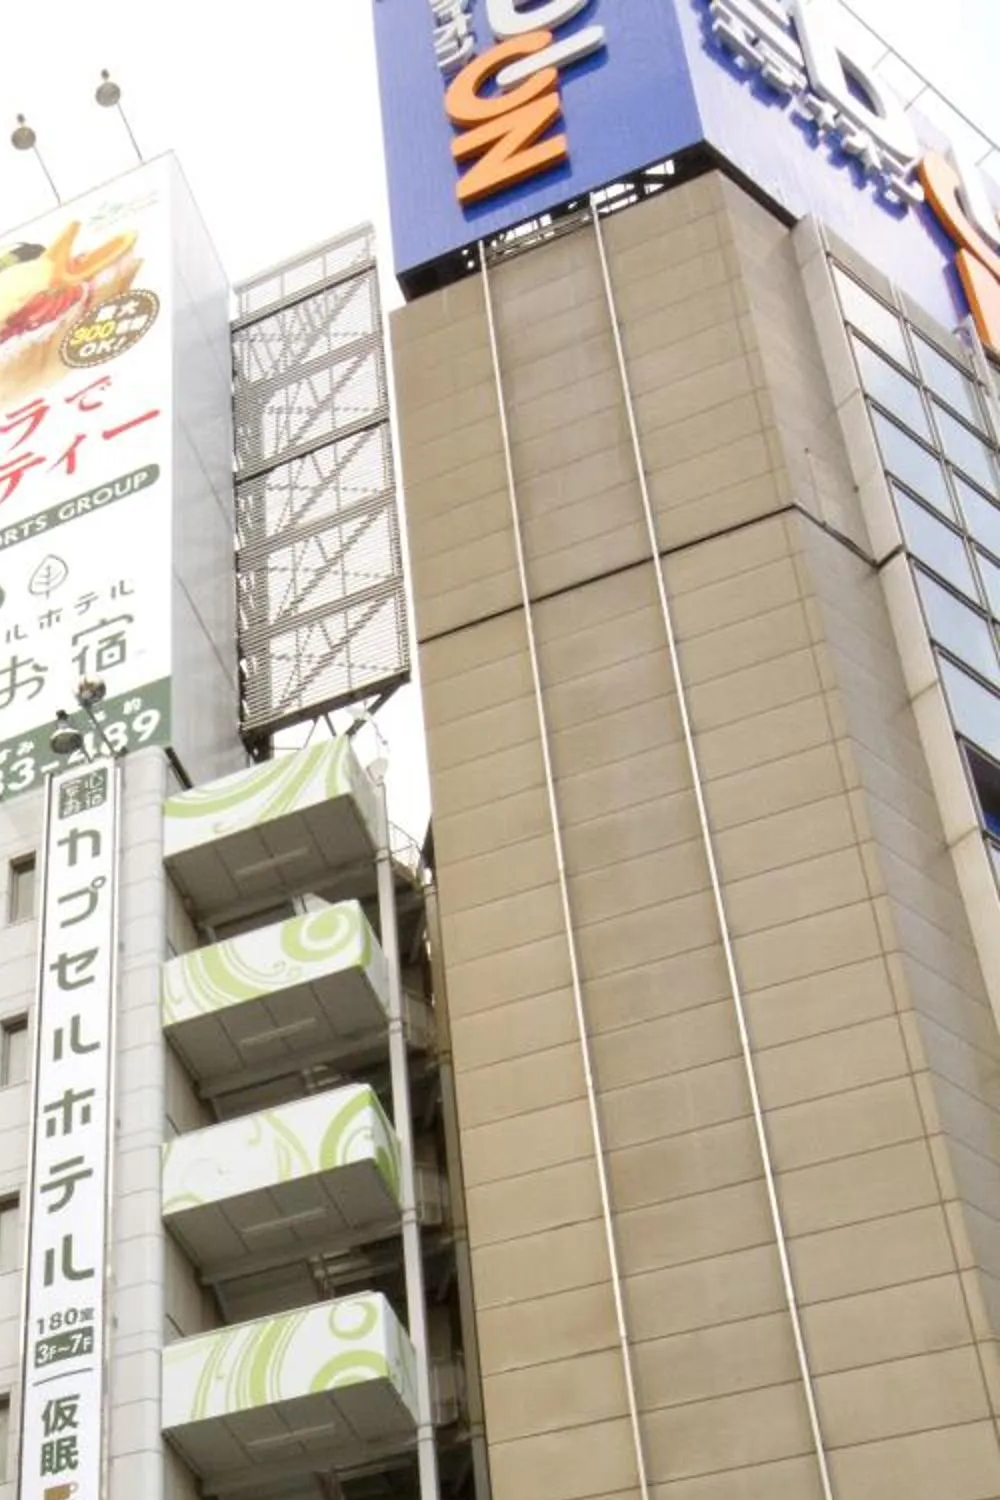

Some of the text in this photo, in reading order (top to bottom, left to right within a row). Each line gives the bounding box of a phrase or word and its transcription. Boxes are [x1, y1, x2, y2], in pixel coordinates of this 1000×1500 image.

[58, 469, 149, 522] GROUP
[40, 826, 107, 1289] カプセルホテル
[39, 1393, 82, 1479] 仮眠
